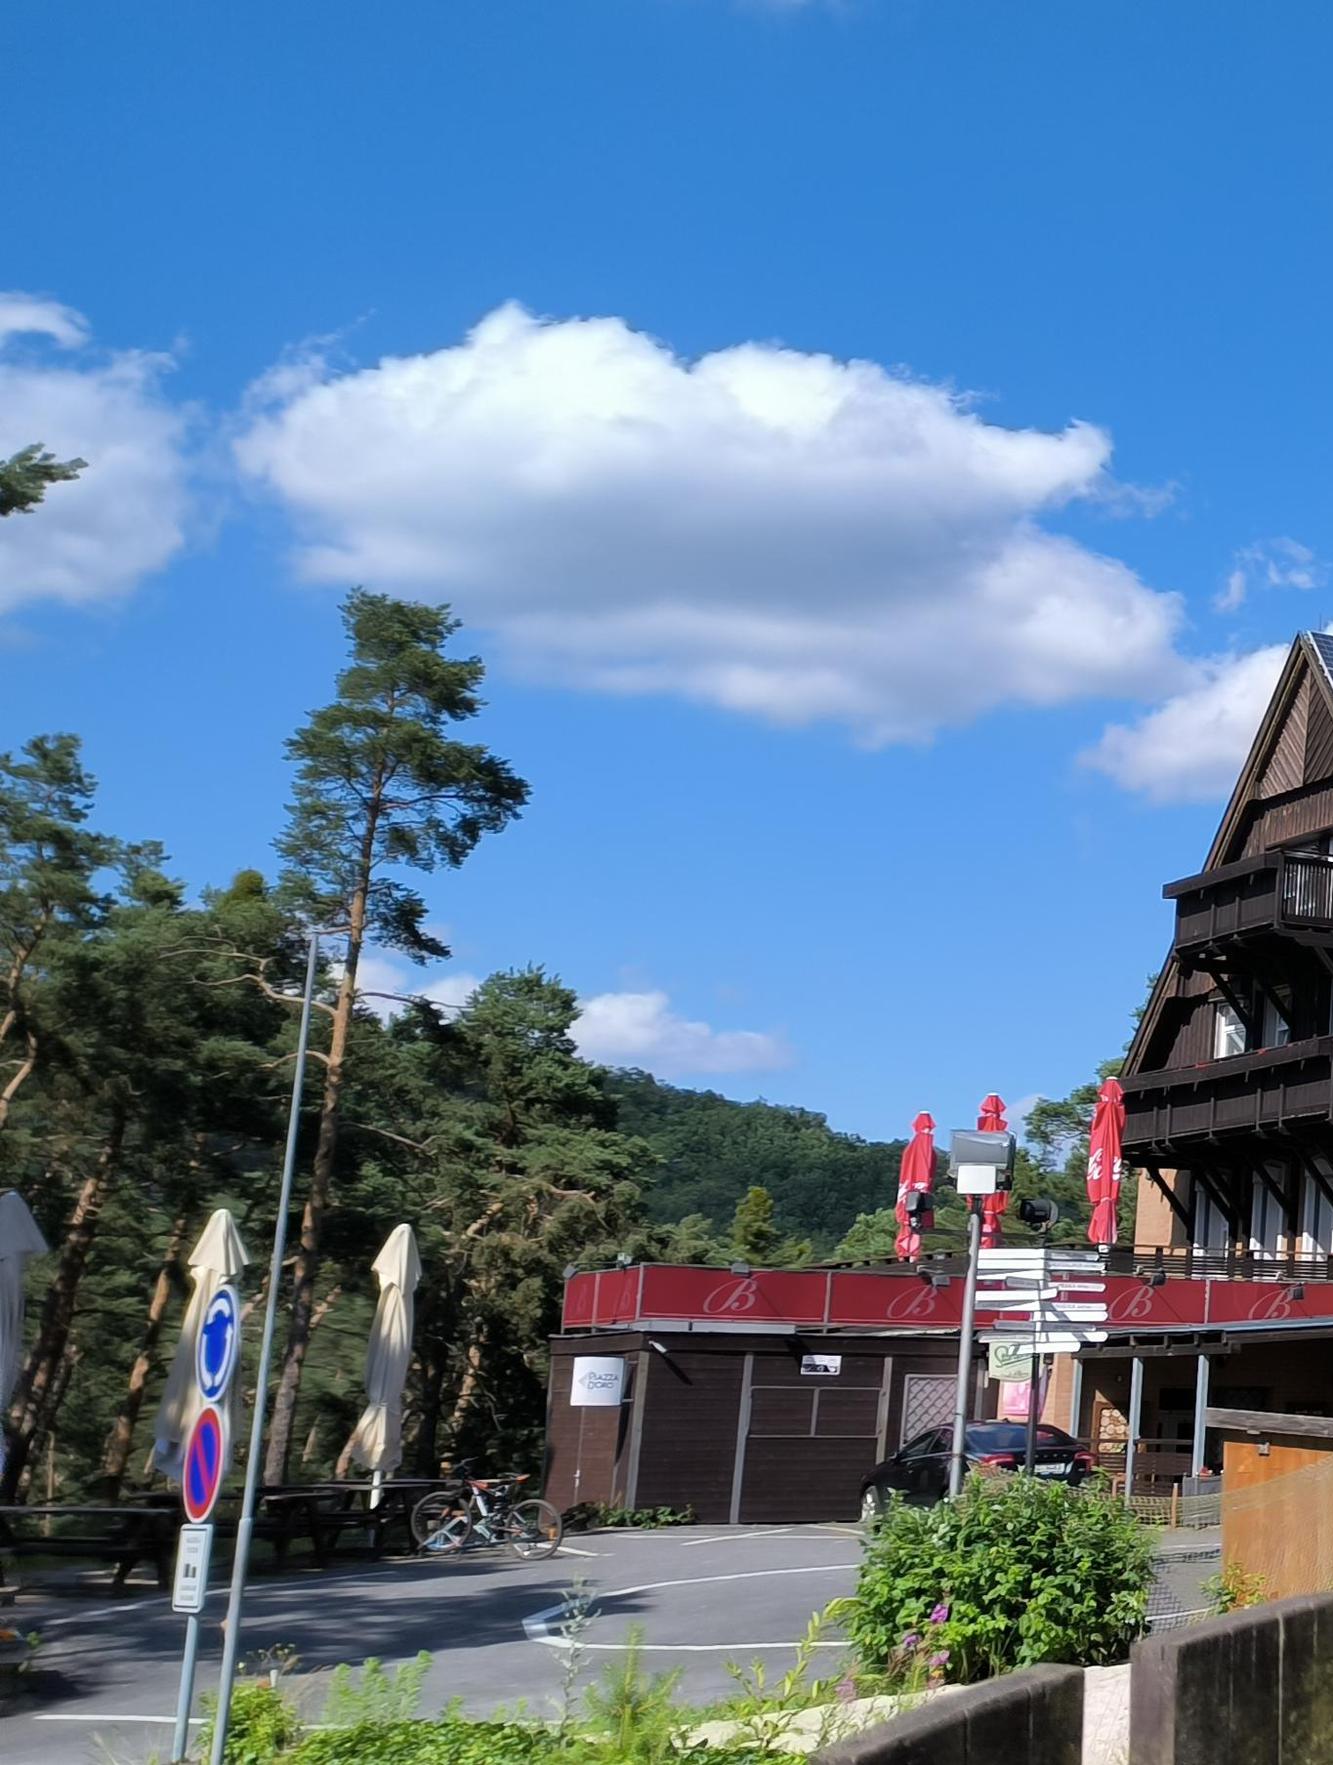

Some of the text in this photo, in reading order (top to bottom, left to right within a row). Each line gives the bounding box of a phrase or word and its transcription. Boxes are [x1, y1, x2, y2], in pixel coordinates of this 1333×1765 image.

[702, 1272, 769, 1314] B
[886, 1284, 938, 1319] B
[1108, 1284, 1154, 1321] B
